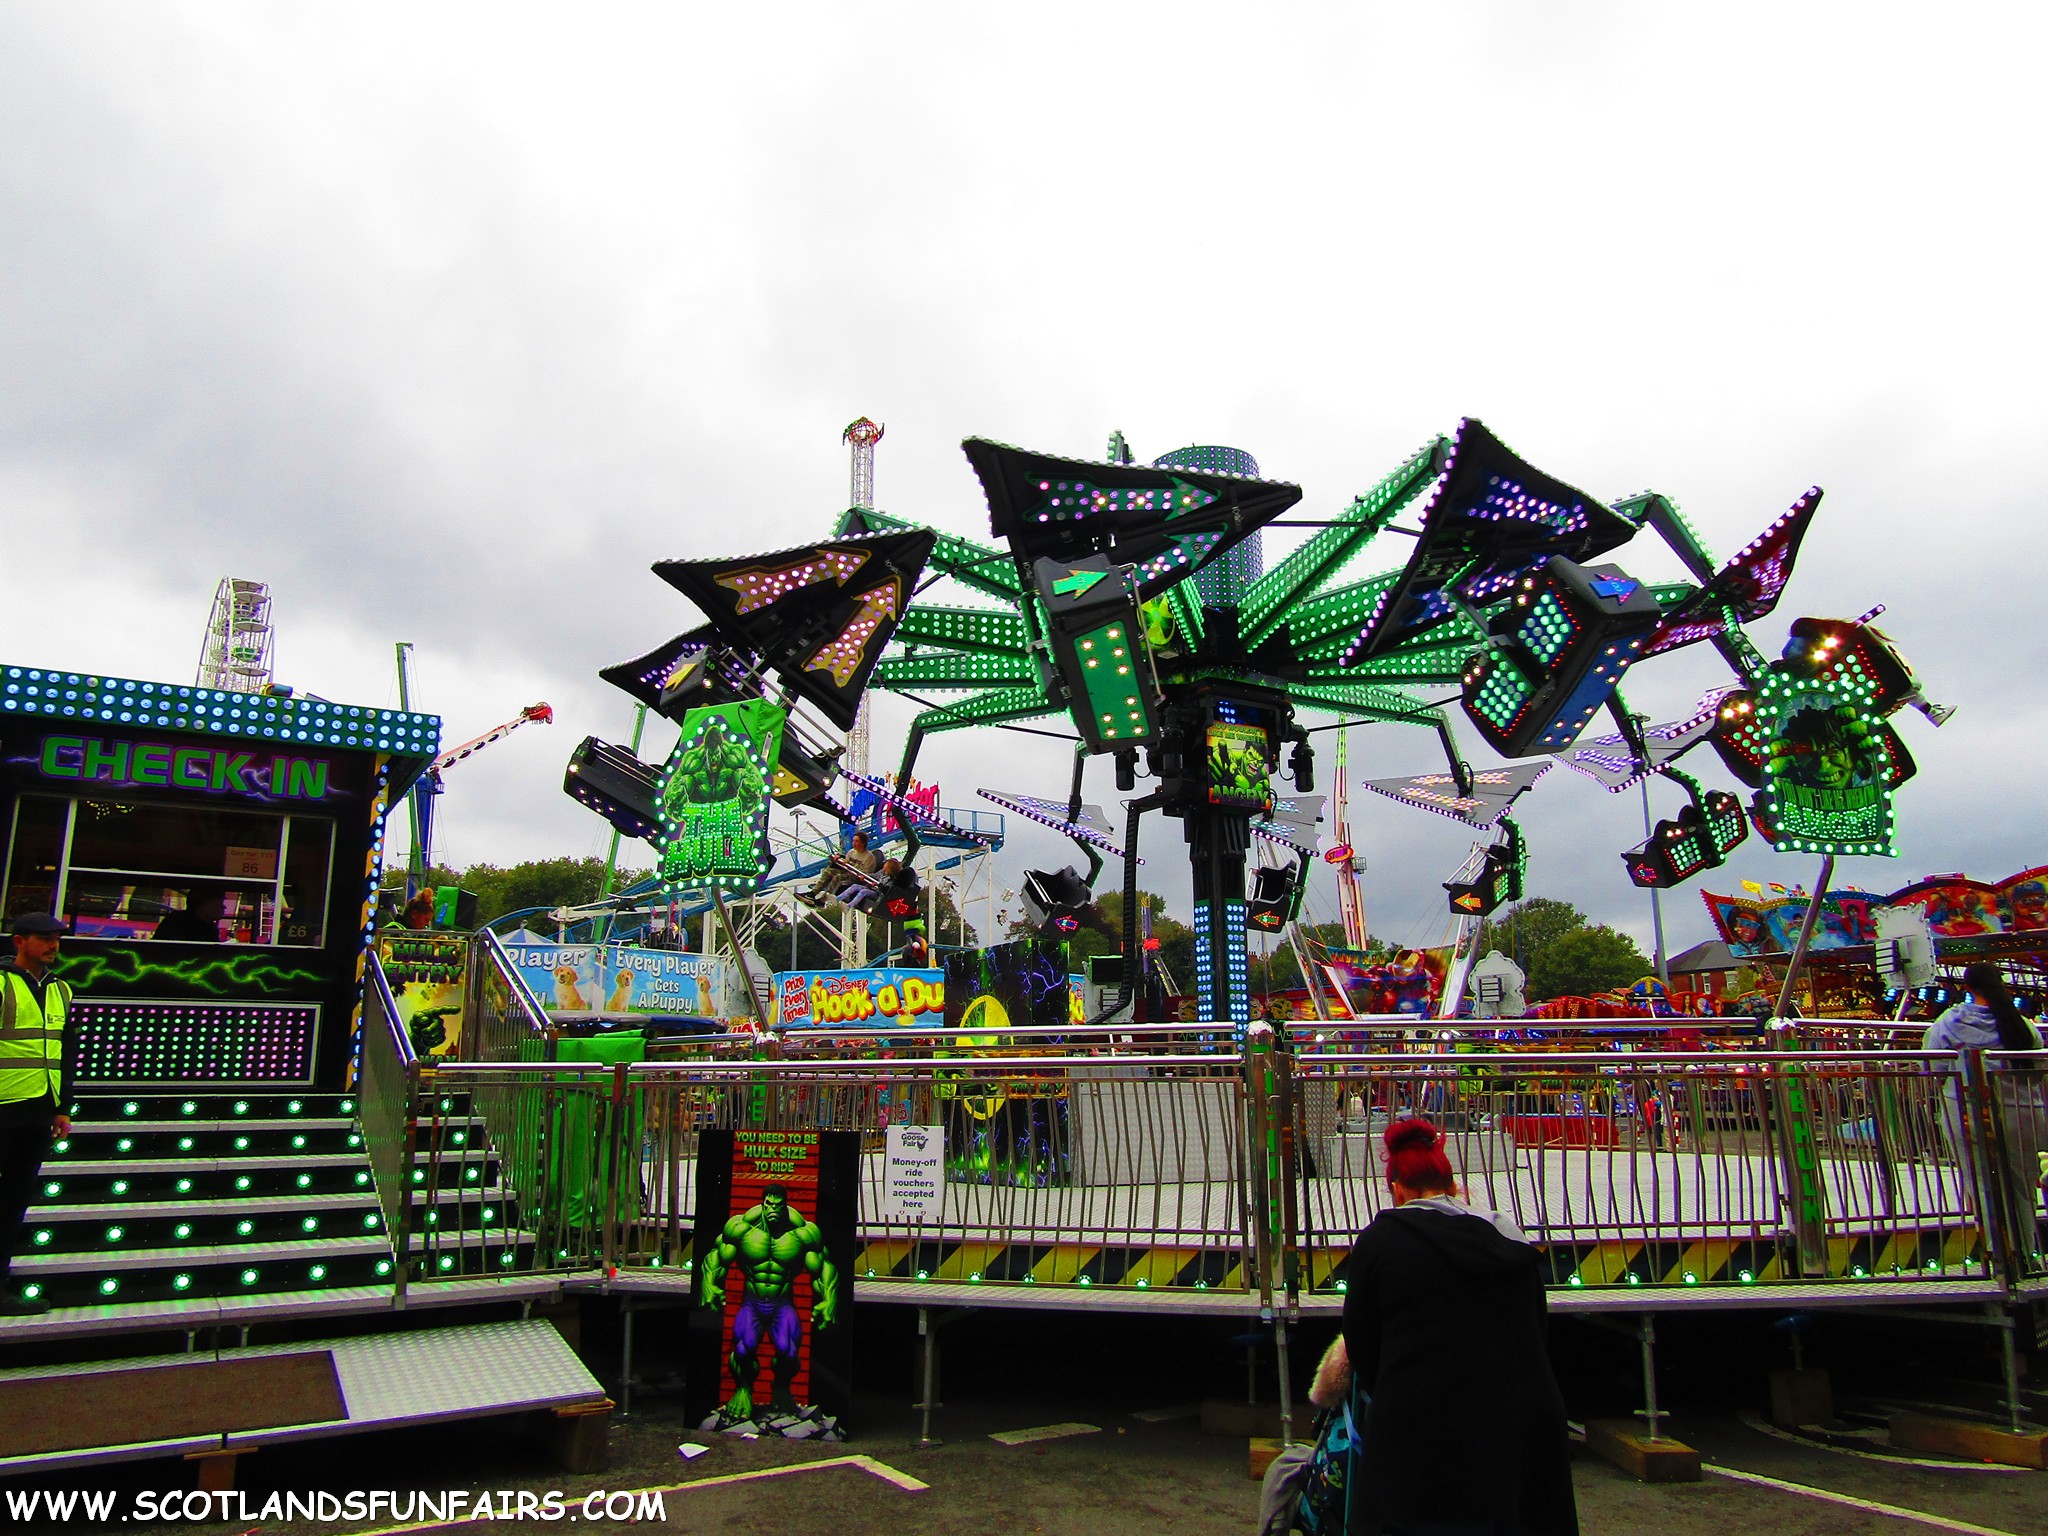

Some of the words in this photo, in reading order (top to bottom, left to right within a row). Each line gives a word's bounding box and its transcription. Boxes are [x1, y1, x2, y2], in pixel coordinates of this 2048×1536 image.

[40, 735, 254, 792] CHECK
[270, 757, 329, 799] IN
[682, 798, 743, 836] THE
[664, 835, 758, 878] HULK
[242, 862, 258, 874] 86
[287, 925, 307, 938] £6
[392, 943, 459, 963] HULK
[505, 947, 587, 972] Player
[384, 963, 464, 984] ENTRY
[616, 950, 662, 977] Every
[664, 956, 716, 980] Player
[655, 977, 681, 994] Gets
[784, 974, 805, 994] Prize
[637, 992, 651, 1009] A
[651, 992, 694, 1014] Puppy
[784, 988, 807, 1009] Every
[877, 984, 902, 1016] a
[902, 977, 945, 1015] Du
[735, 1131, 757, 1143] YOU
[758, 1132, 786, 1144] NEED
[787, 1133, 802, 1144] TO
[803, 1134, 818, 1145] BE
[901, 1133, 926, 1141] Goose
[743, 1144, 778, 1159] HULK
[779, 1146, 807, 1160] SIZE
[754, 1160, 769, 1171] TO
[770, 1161, 795, 1173] RIDE
[892, 1158, 938, 1168] Money-off
[905, 1168, 923, 1177] ride
[893, 1179, 935, 1188] vouchers
[892, 1189, 935, 1199] accepted
[902, 1199, 924, 1208] here
